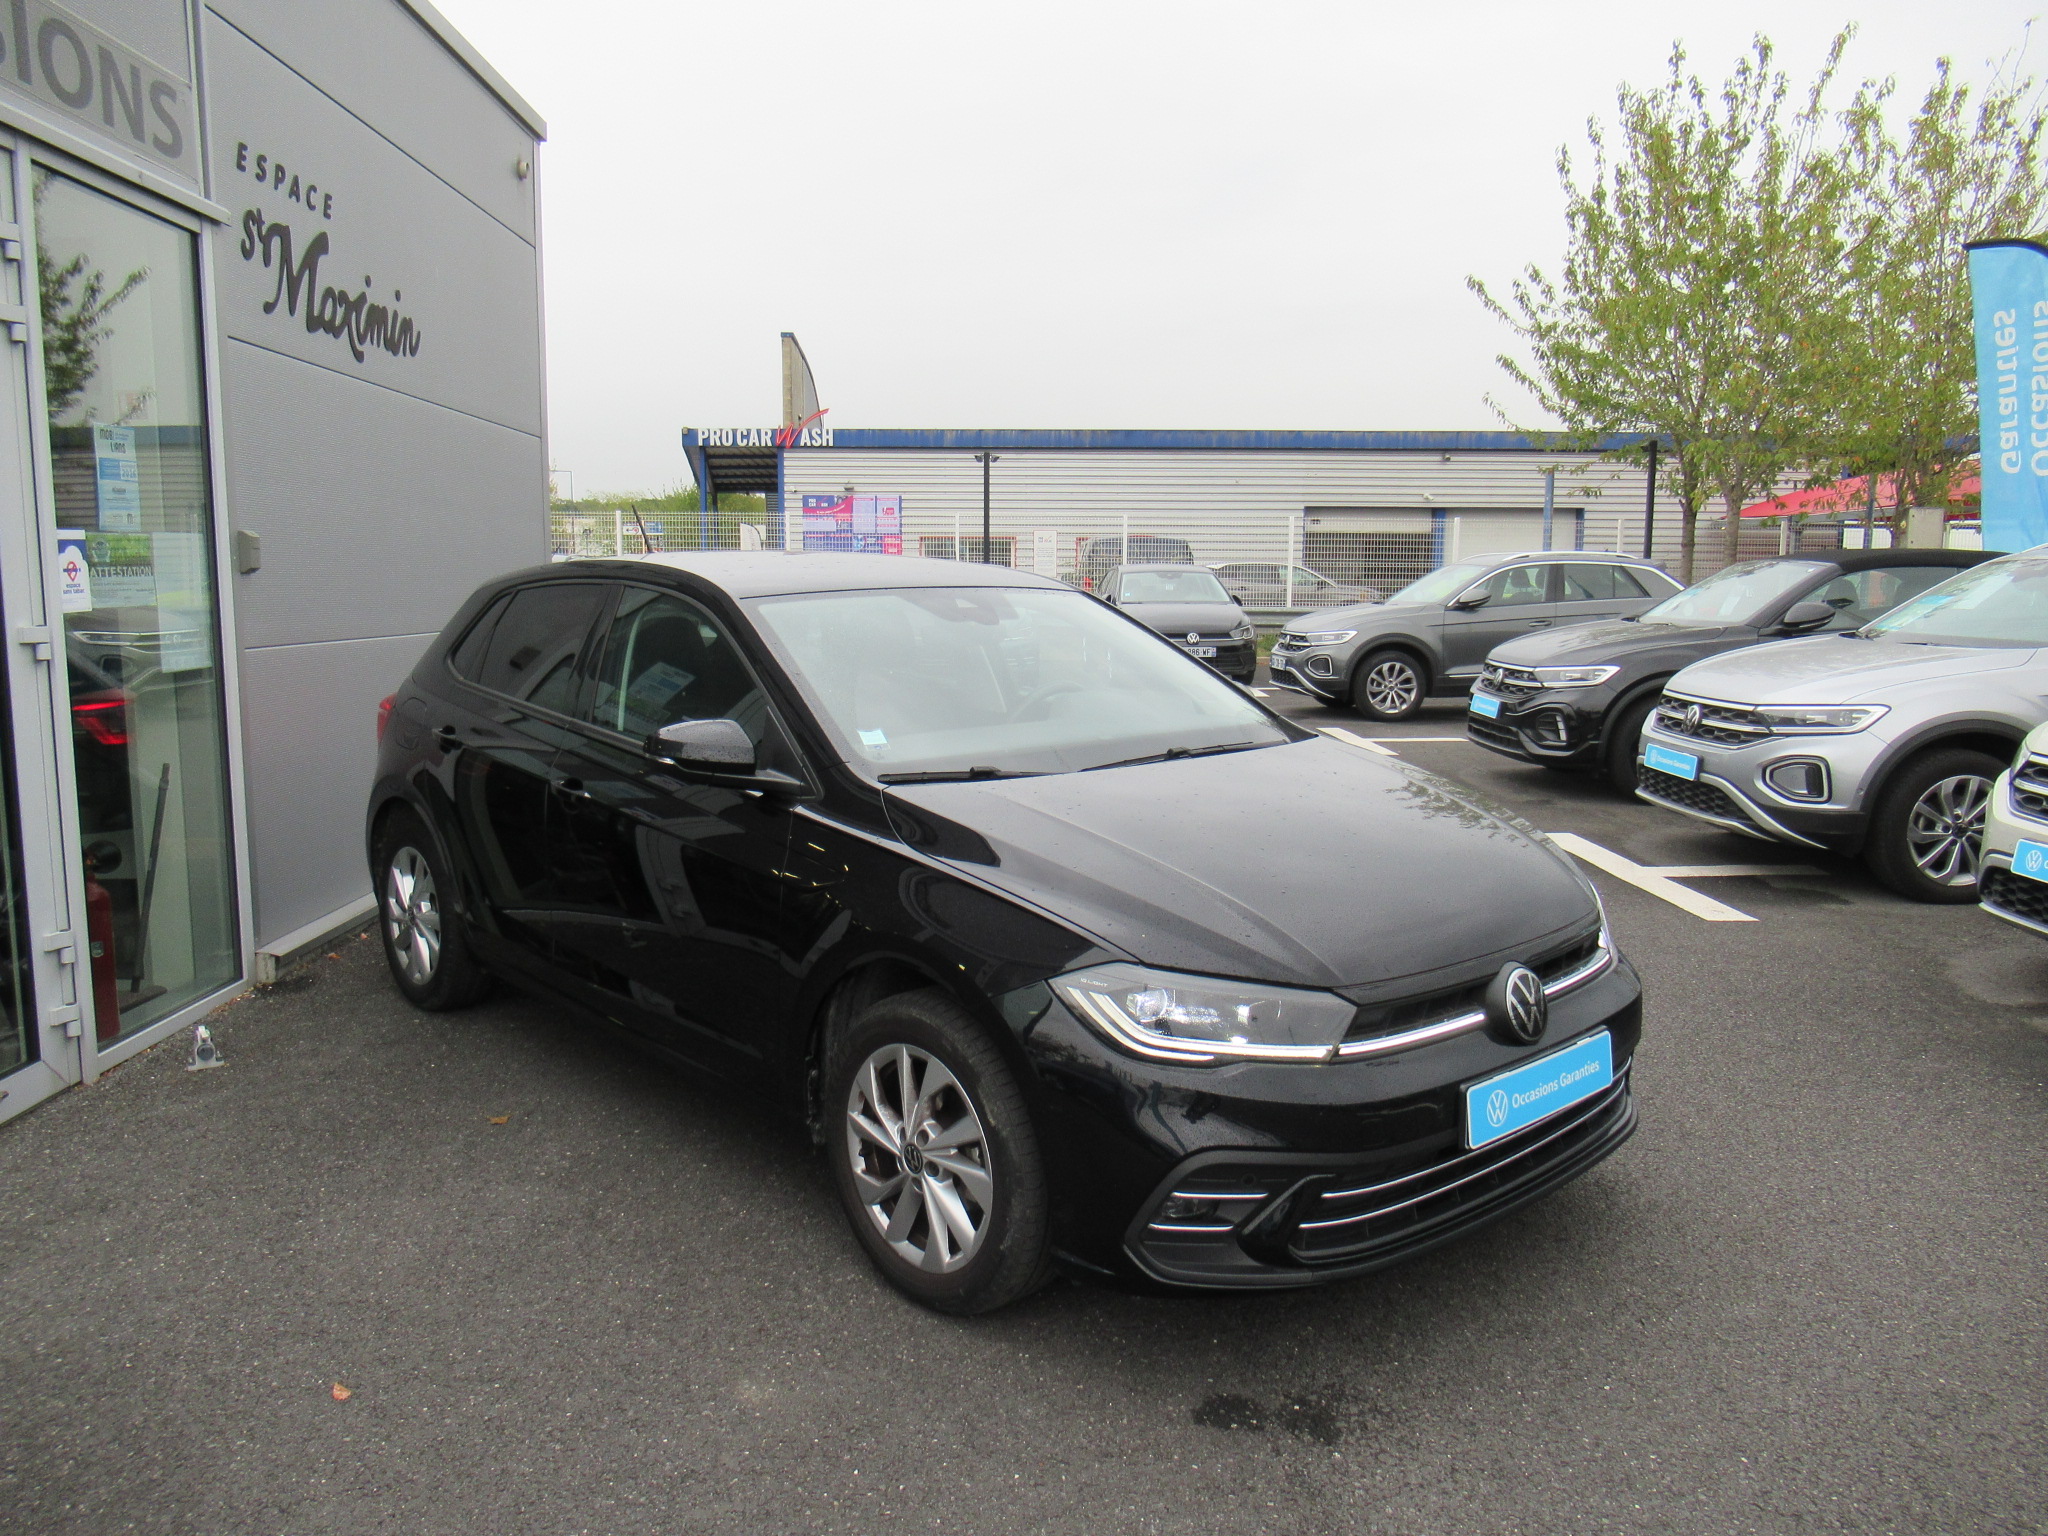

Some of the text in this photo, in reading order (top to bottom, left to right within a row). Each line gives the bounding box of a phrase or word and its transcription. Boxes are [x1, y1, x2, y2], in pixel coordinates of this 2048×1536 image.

[0, 0, 183, 159] IONS
[236, 142, 333, 220] ESPACE
[262, 222, 421, 363] Maximin
[697, 411, 834, 449] PRO CAR WASH
[90, 565, 152, 578] ATTESTATION
[1512, 1078, 1559, 1109] Occasions
[1559, 1060, 1600, 1087] Garanties
